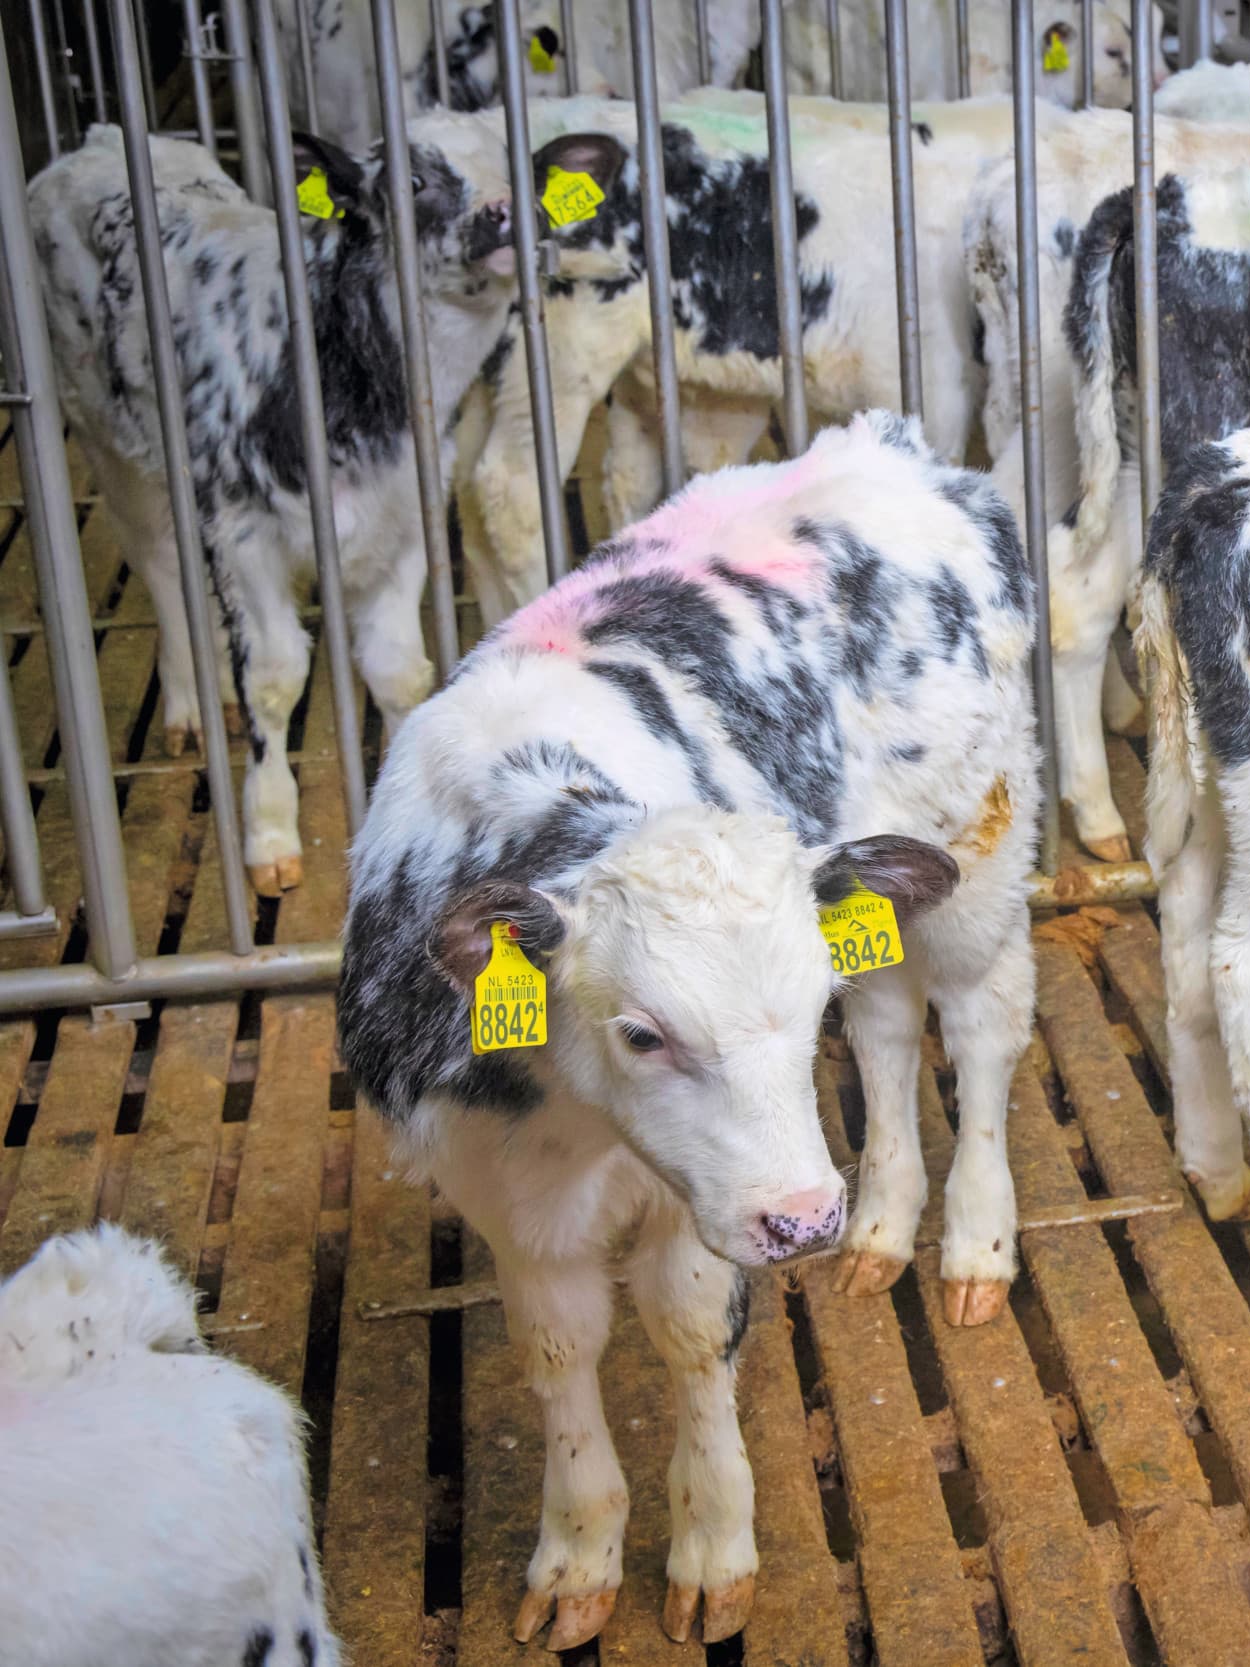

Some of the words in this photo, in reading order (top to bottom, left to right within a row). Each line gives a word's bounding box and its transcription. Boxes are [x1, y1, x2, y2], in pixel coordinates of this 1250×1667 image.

[831, 908, 853, 922] 5423
[855, 902, 877, 917] 8842
[828, 930, 895, 972] 8842
[488, 977, 502, 987] NL
[507, 974, 534, 986] 5423
[479, 1001, 538, 1046] 8842
